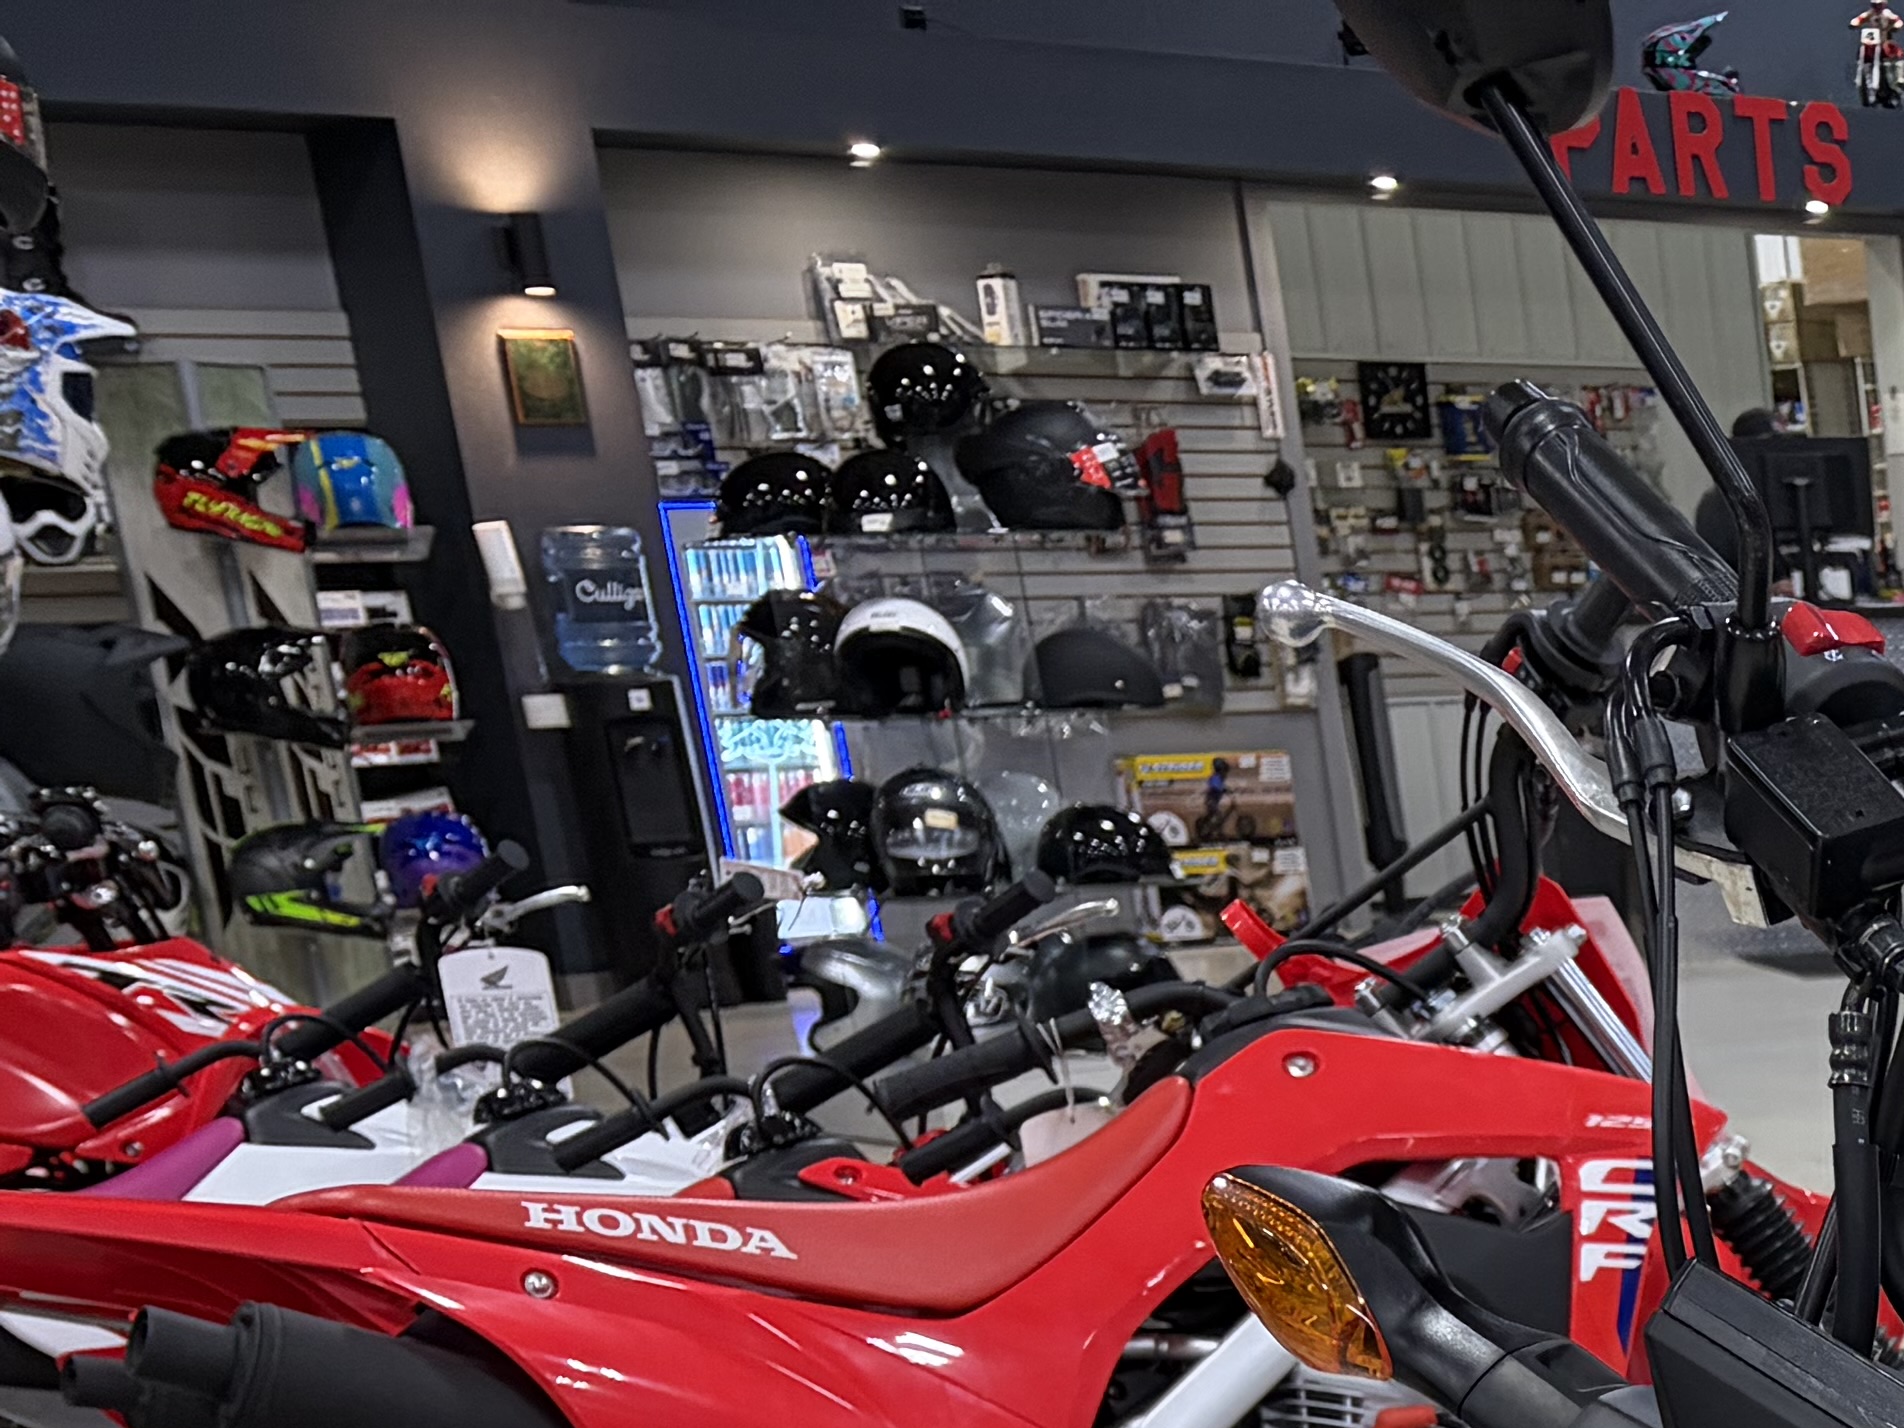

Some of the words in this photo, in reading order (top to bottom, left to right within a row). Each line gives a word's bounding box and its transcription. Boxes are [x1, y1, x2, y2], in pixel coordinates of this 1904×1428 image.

[575, 579, 645, 611] Culliga
[520, 1201, 798, 1260] HONDA
[1579, 1159, 1656, 1282] CRF
